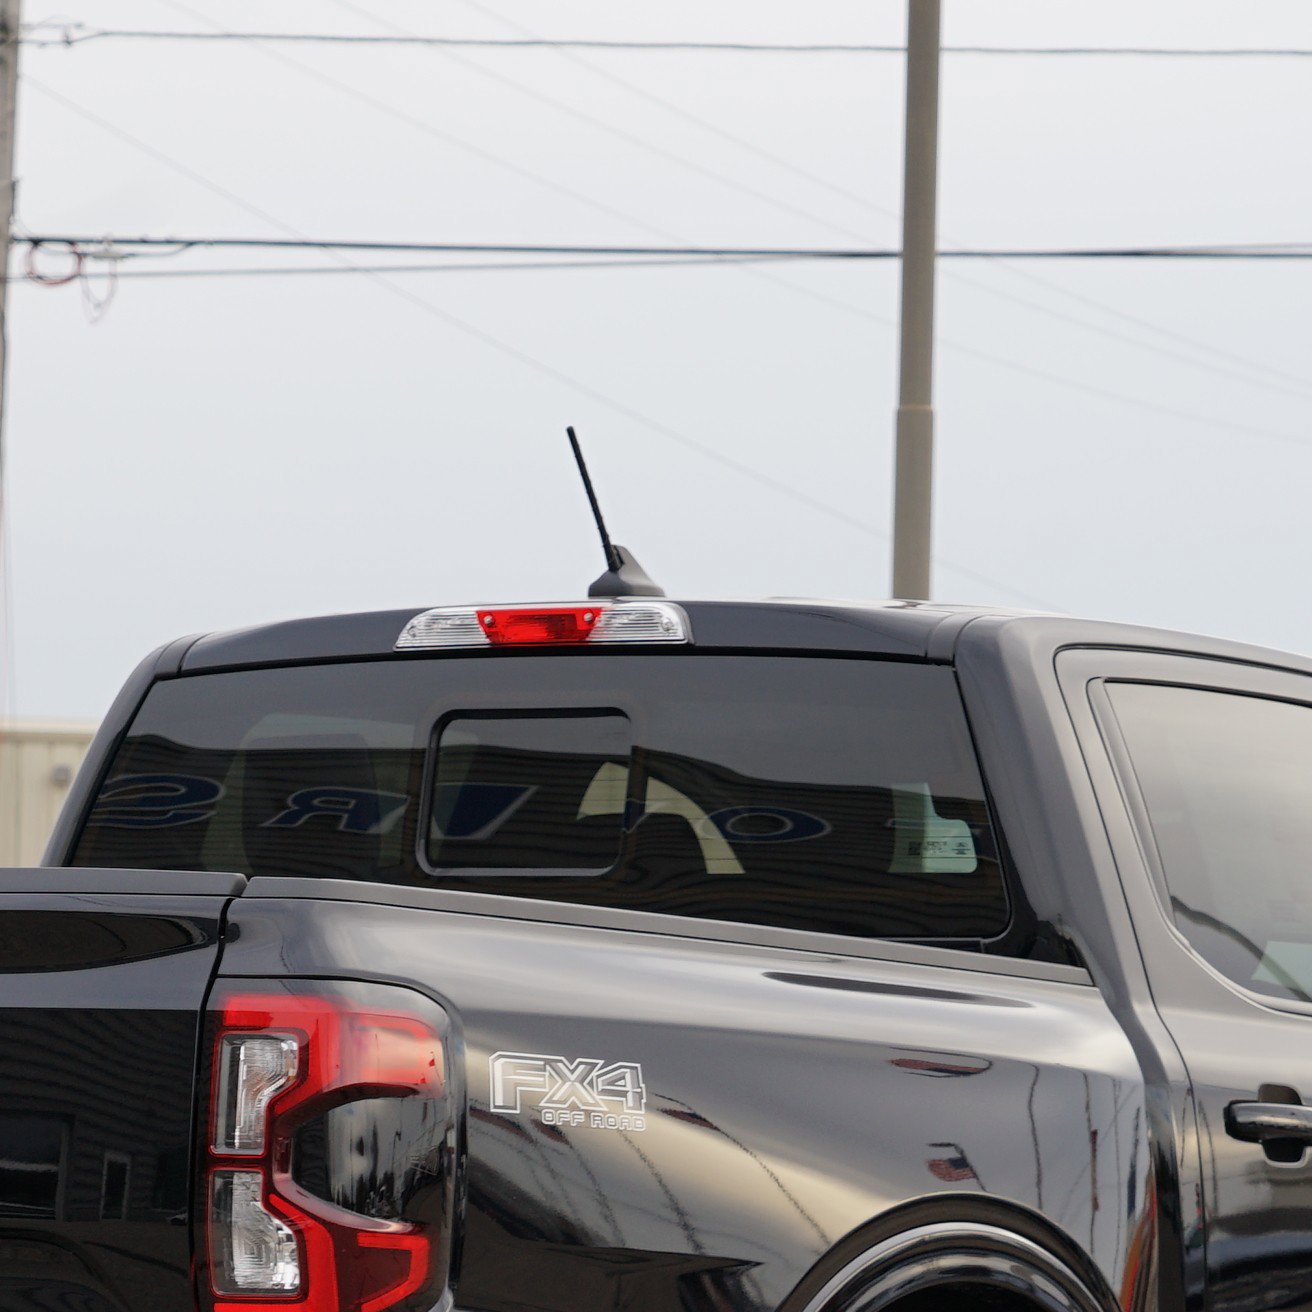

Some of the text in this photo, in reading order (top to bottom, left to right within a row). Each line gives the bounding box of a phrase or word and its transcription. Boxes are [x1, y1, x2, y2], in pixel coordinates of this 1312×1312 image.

[488, 1051, 647, 1114] FX4
[541, 1108, 647, 1132] OFF ROAD
